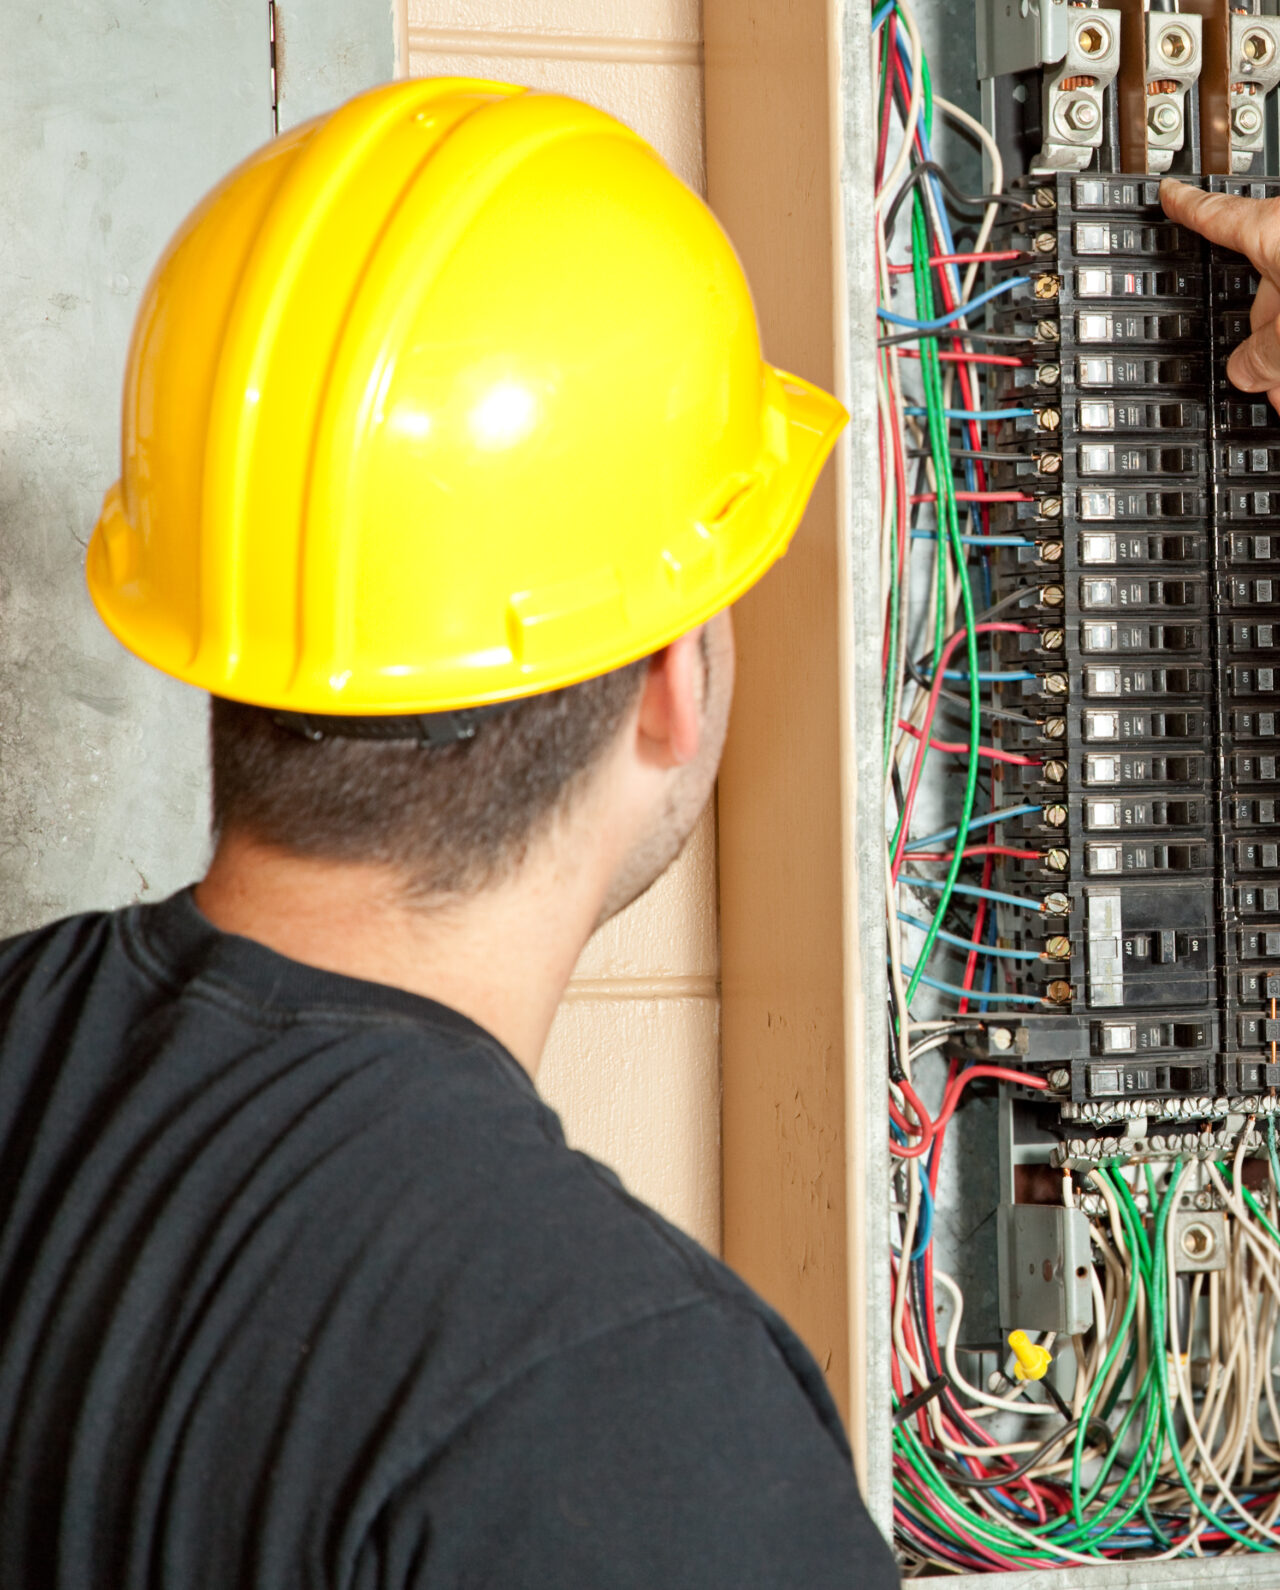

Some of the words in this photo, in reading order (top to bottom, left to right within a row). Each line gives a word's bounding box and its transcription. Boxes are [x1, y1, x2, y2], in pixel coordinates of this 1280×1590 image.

[1113, 189, 1121, 205] OFF
[1179, 278, 1185, 287] 20
[1234, 277, 1241, 289] ON
[1234, 320, 1240, 332] ON
[1237, 452, 1244, 464] ON
[1240, 496, 1246, 508] ON
[1239, 583, 1245, 595] ON
[1241, 627, 1248, 639] ON
[1242, 671, 1249, 683] ON
[1243, 715, 1250, 727] ON
[1244, 759, 1250, 771] ON
[1241, 805, 1247, 817] ON
[1247, 847, 1254, 858] ON
[1246, 894, 1253, 905] ON
[1192, 940, 1199, 951] ON
[1250, 937, 1256, 948] ON
[1250, 978, 1256, 989] ON
[1249, 1021, 1256, 1032] ON
[1251, 1069, 1257, 1080] ON
